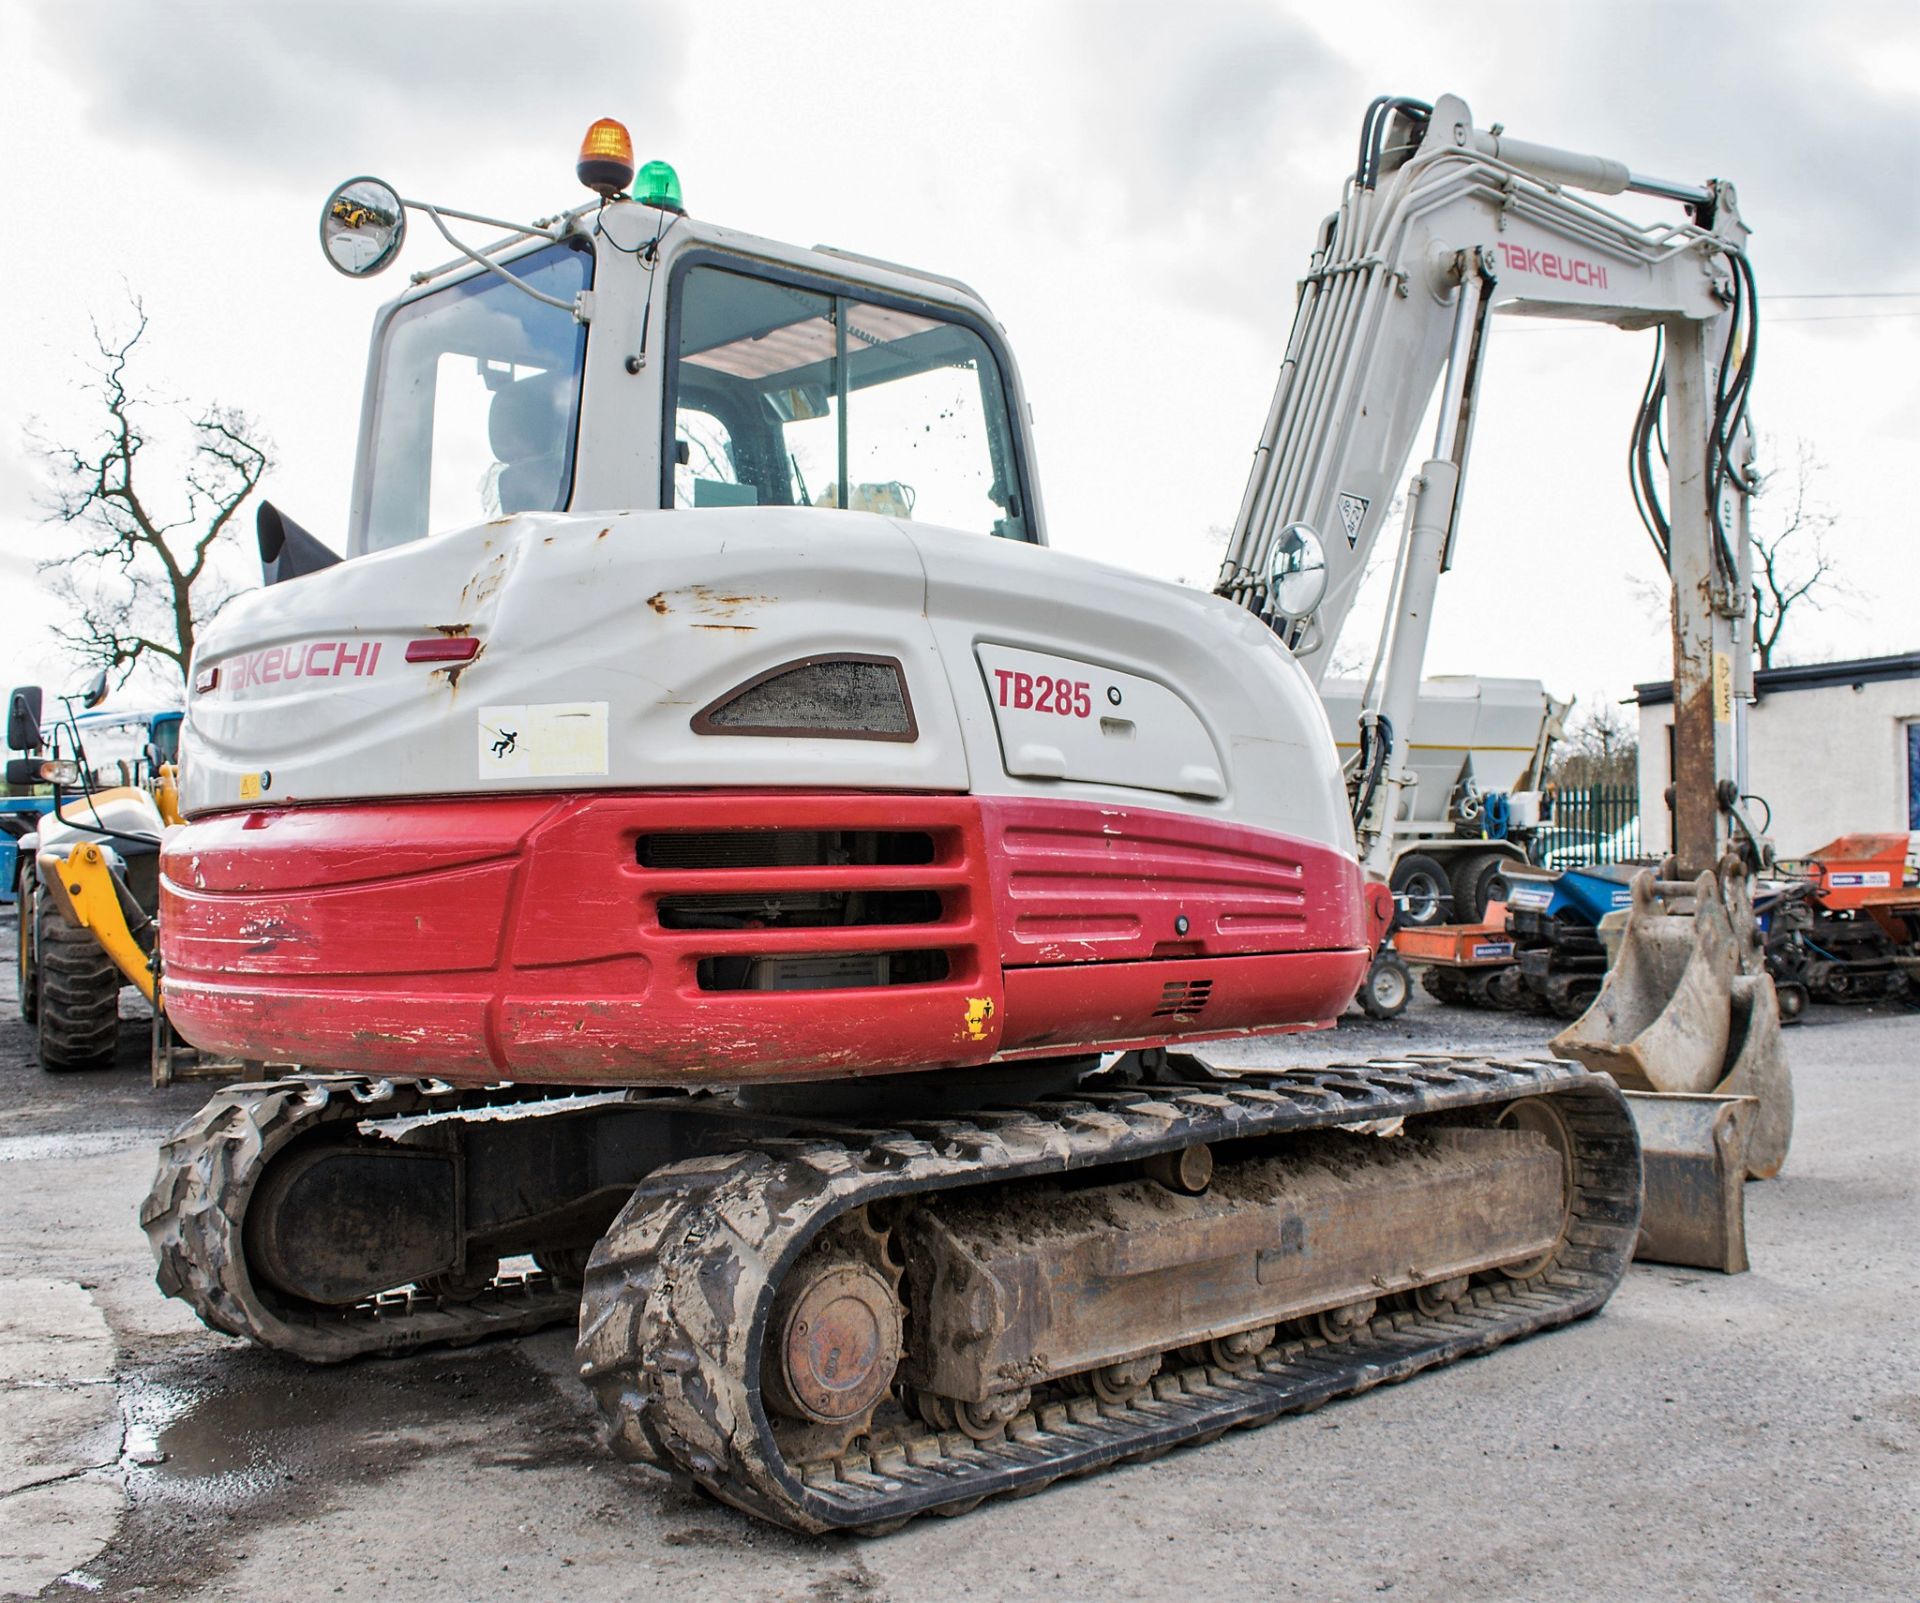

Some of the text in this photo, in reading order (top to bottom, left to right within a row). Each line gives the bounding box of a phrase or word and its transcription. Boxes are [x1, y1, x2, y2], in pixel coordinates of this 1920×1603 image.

[1498, 242, 1608, 289] TAKEUCHI
[221, 642, 382, 691] TAKEUCHI
[995, 669, 1091, 718] TB285
